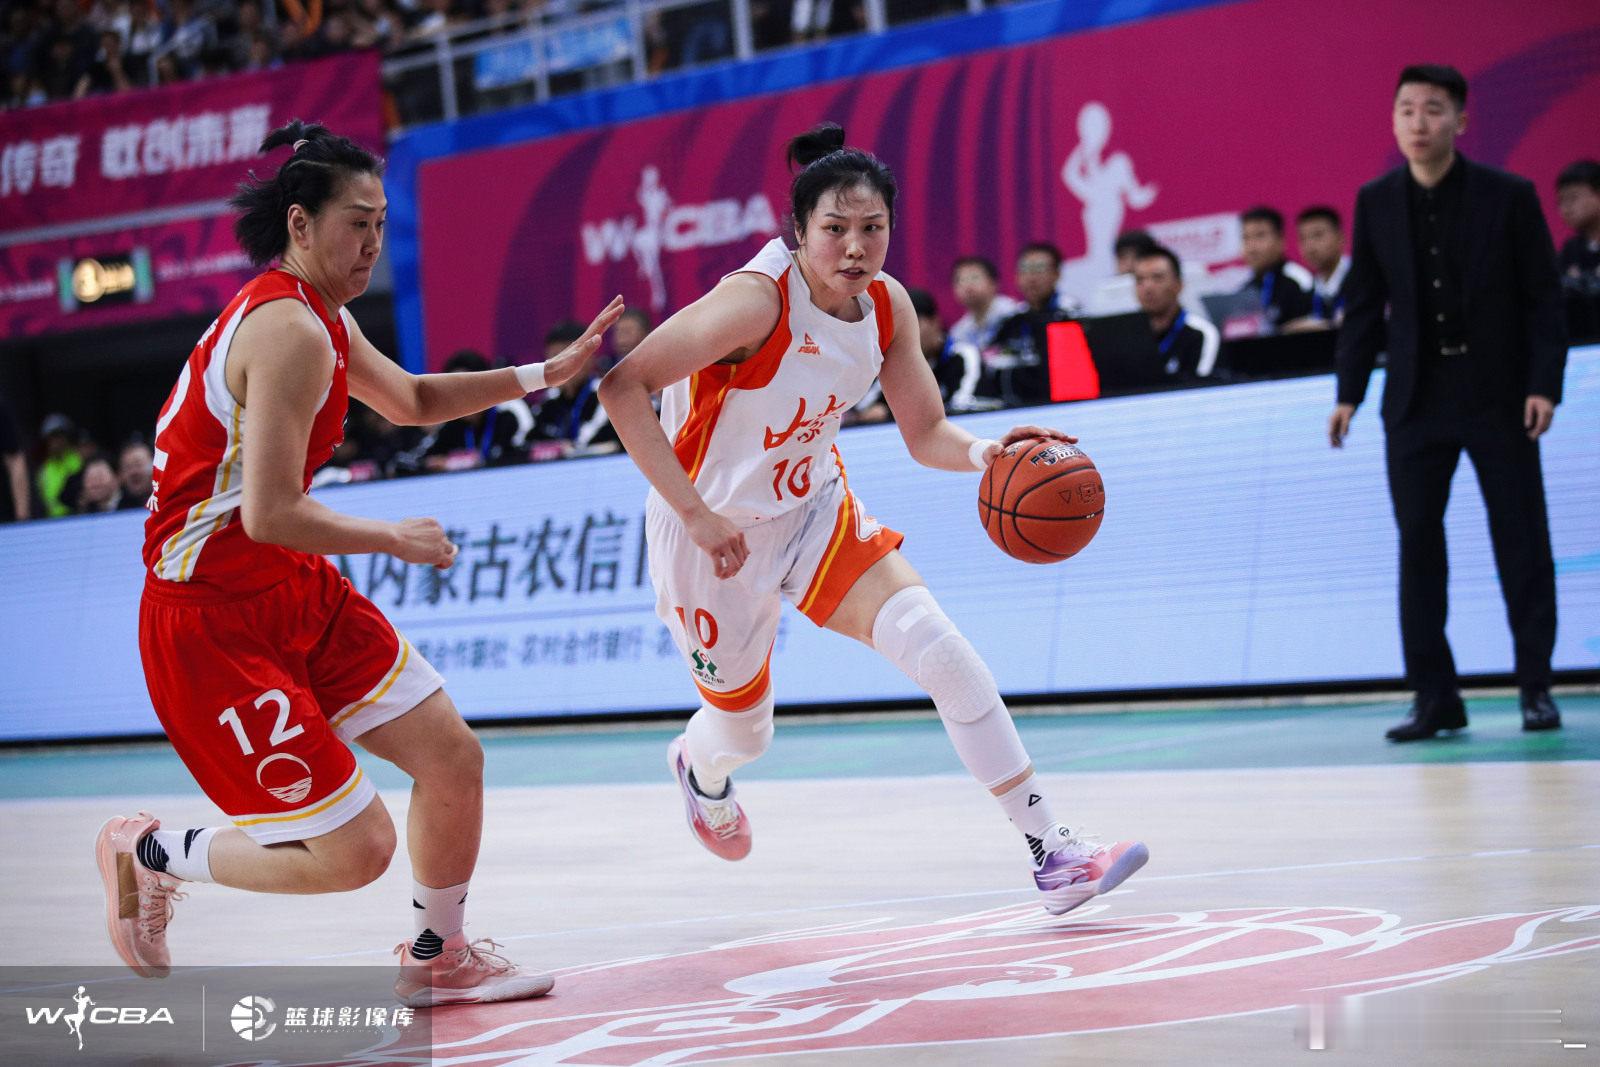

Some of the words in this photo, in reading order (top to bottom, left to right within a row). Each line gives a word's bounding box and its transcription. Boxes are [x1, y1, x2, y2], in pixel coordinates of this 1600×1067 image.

[581, 194, 778, 267] WCBA
[772, 455, 814, 502] 10
[365, 505, 632, 606] 内蒙古农信
[674, 606, 719, 650] 10
[218, 688, 305, 756] 12
